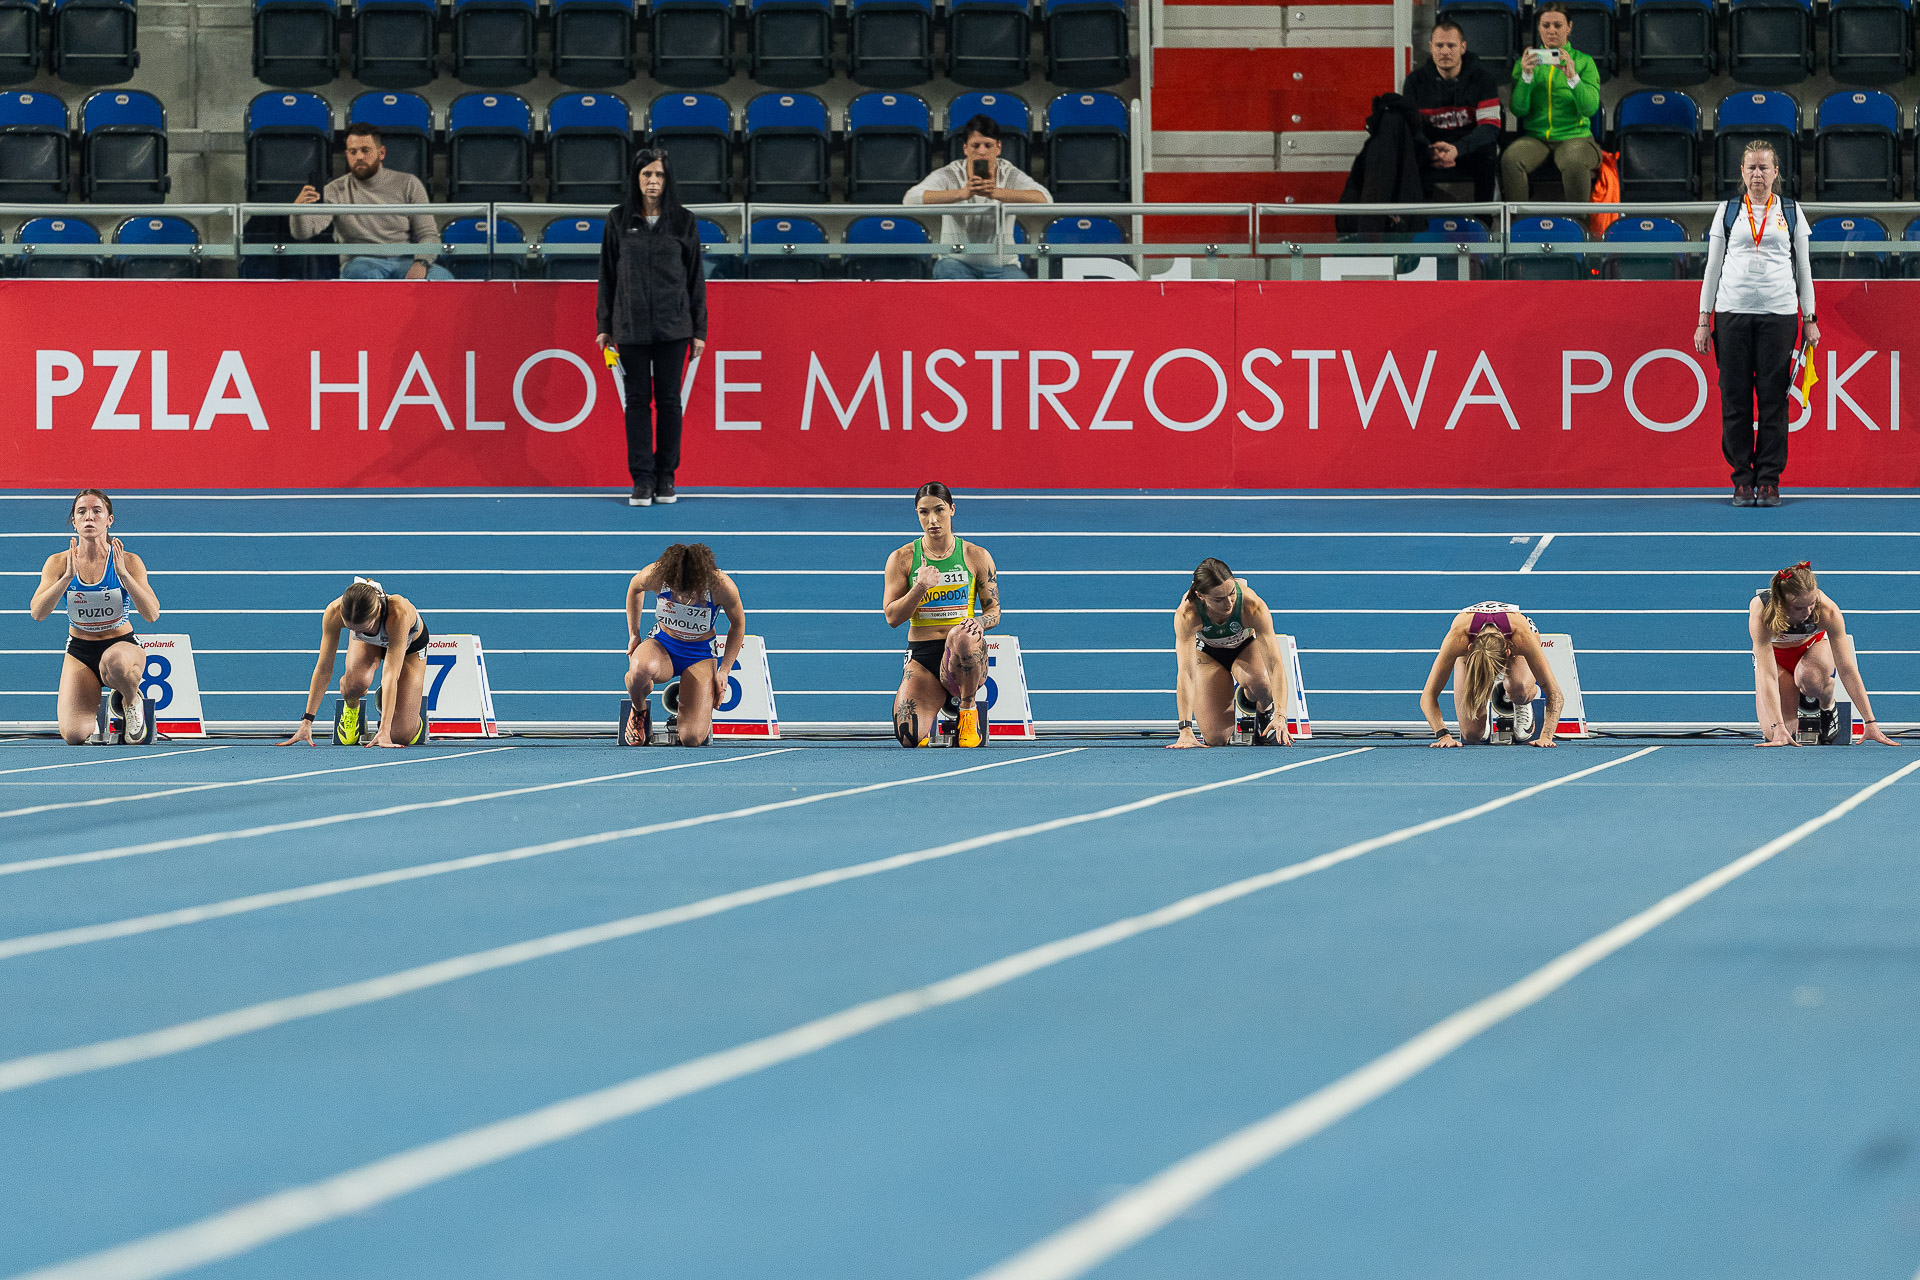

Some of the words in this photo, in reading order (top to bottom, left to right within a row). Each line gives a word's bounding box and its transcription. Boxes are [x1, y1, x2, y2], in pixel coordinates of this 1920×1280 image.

[36, 350, 270, 430] PZLA
[801, 348, 1521, 432] MISTRZOSTWA
[944, 573, 964, 583] 311
[104, 592, 111, 601] 5
[921, 589, 967, 602] WOBODA
[78, 607, 114, 618] PUZIO
[687, 607, 707, 619] 374
[139, 654, 174, 711] 8
[426, 654, 457, 711] 7
